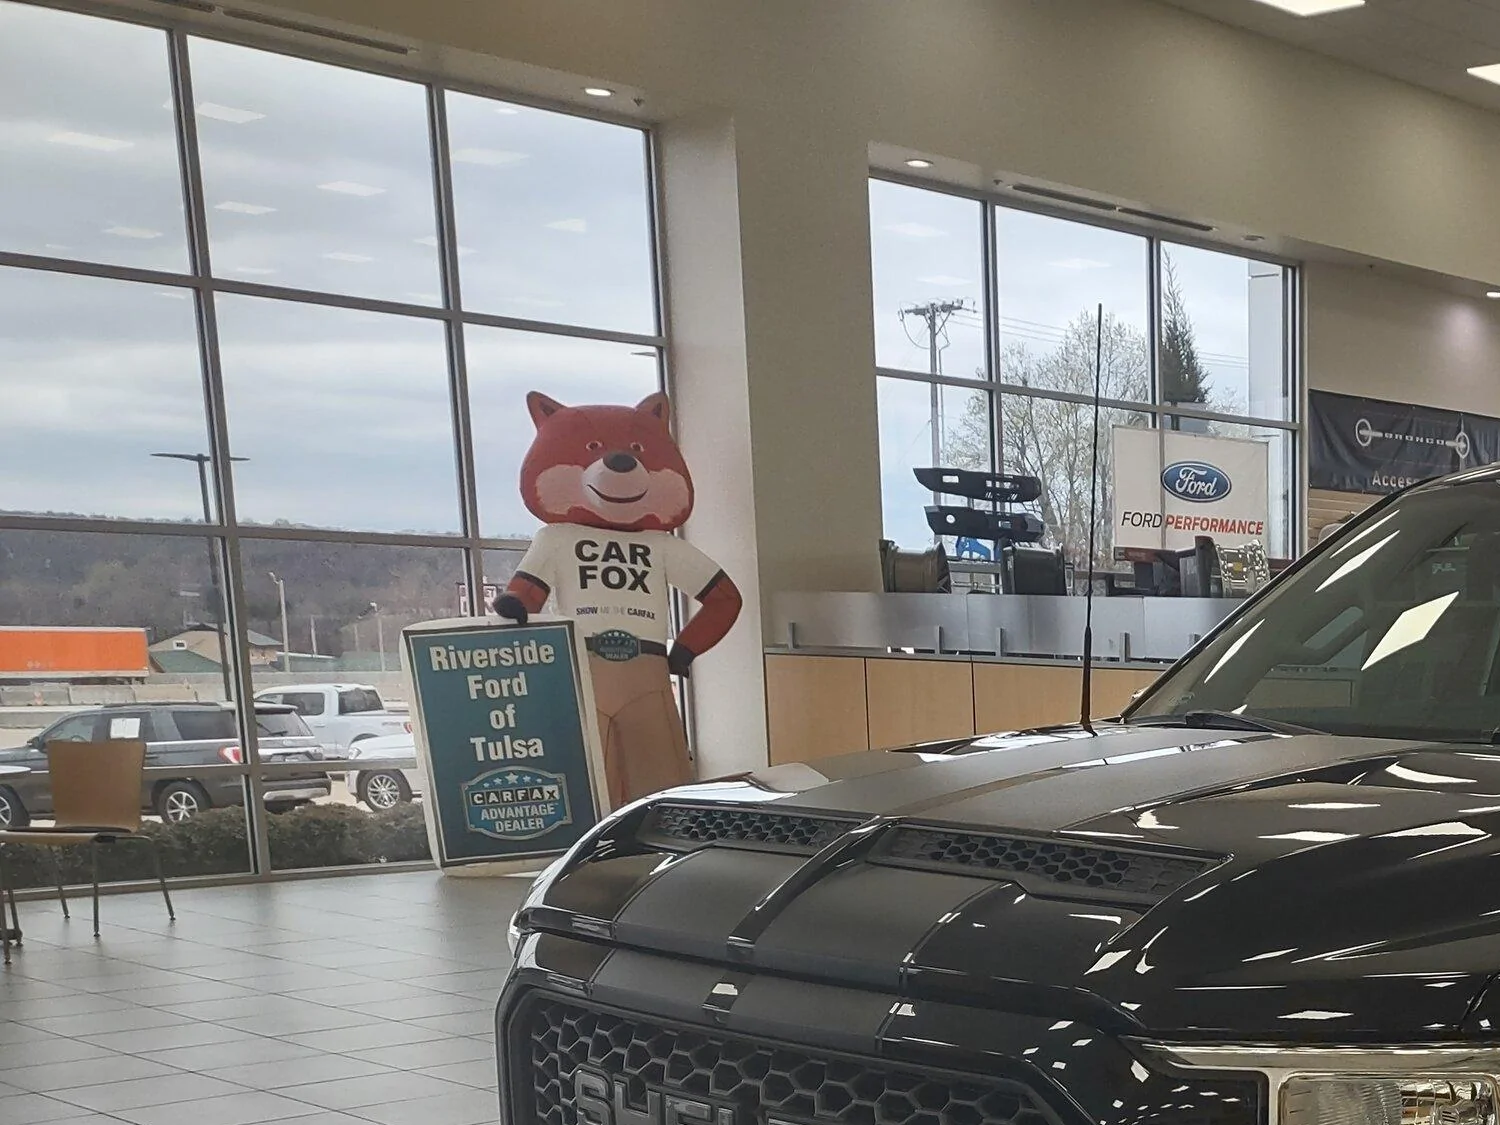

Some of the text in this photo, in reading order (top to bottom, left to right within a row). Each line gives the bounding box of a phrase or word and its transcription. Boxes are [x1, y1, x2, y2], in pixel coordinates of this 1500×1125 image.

[1175, 466, 1218, 497] Ford
[1121, 511, 1264, 536] FORD PERFORMANCE
[574, 539, 652, 568] CAR
[578, 565, 652, 595] FOX
[576, 606, 599, 616] SHOW
[627, 607, 656, 621] CARFAX
[429, 639, 555, 671] Riverside
[467, 671, 529, 700] Ford
[489, 703, 516, 730] of
[470, 735, 544, 762] Tulsa
[472, 785, 559, 805] CARFAX
[481, 803, 556, 821] ADVANTAGE
[495, 818, 545, 833] DEALER
